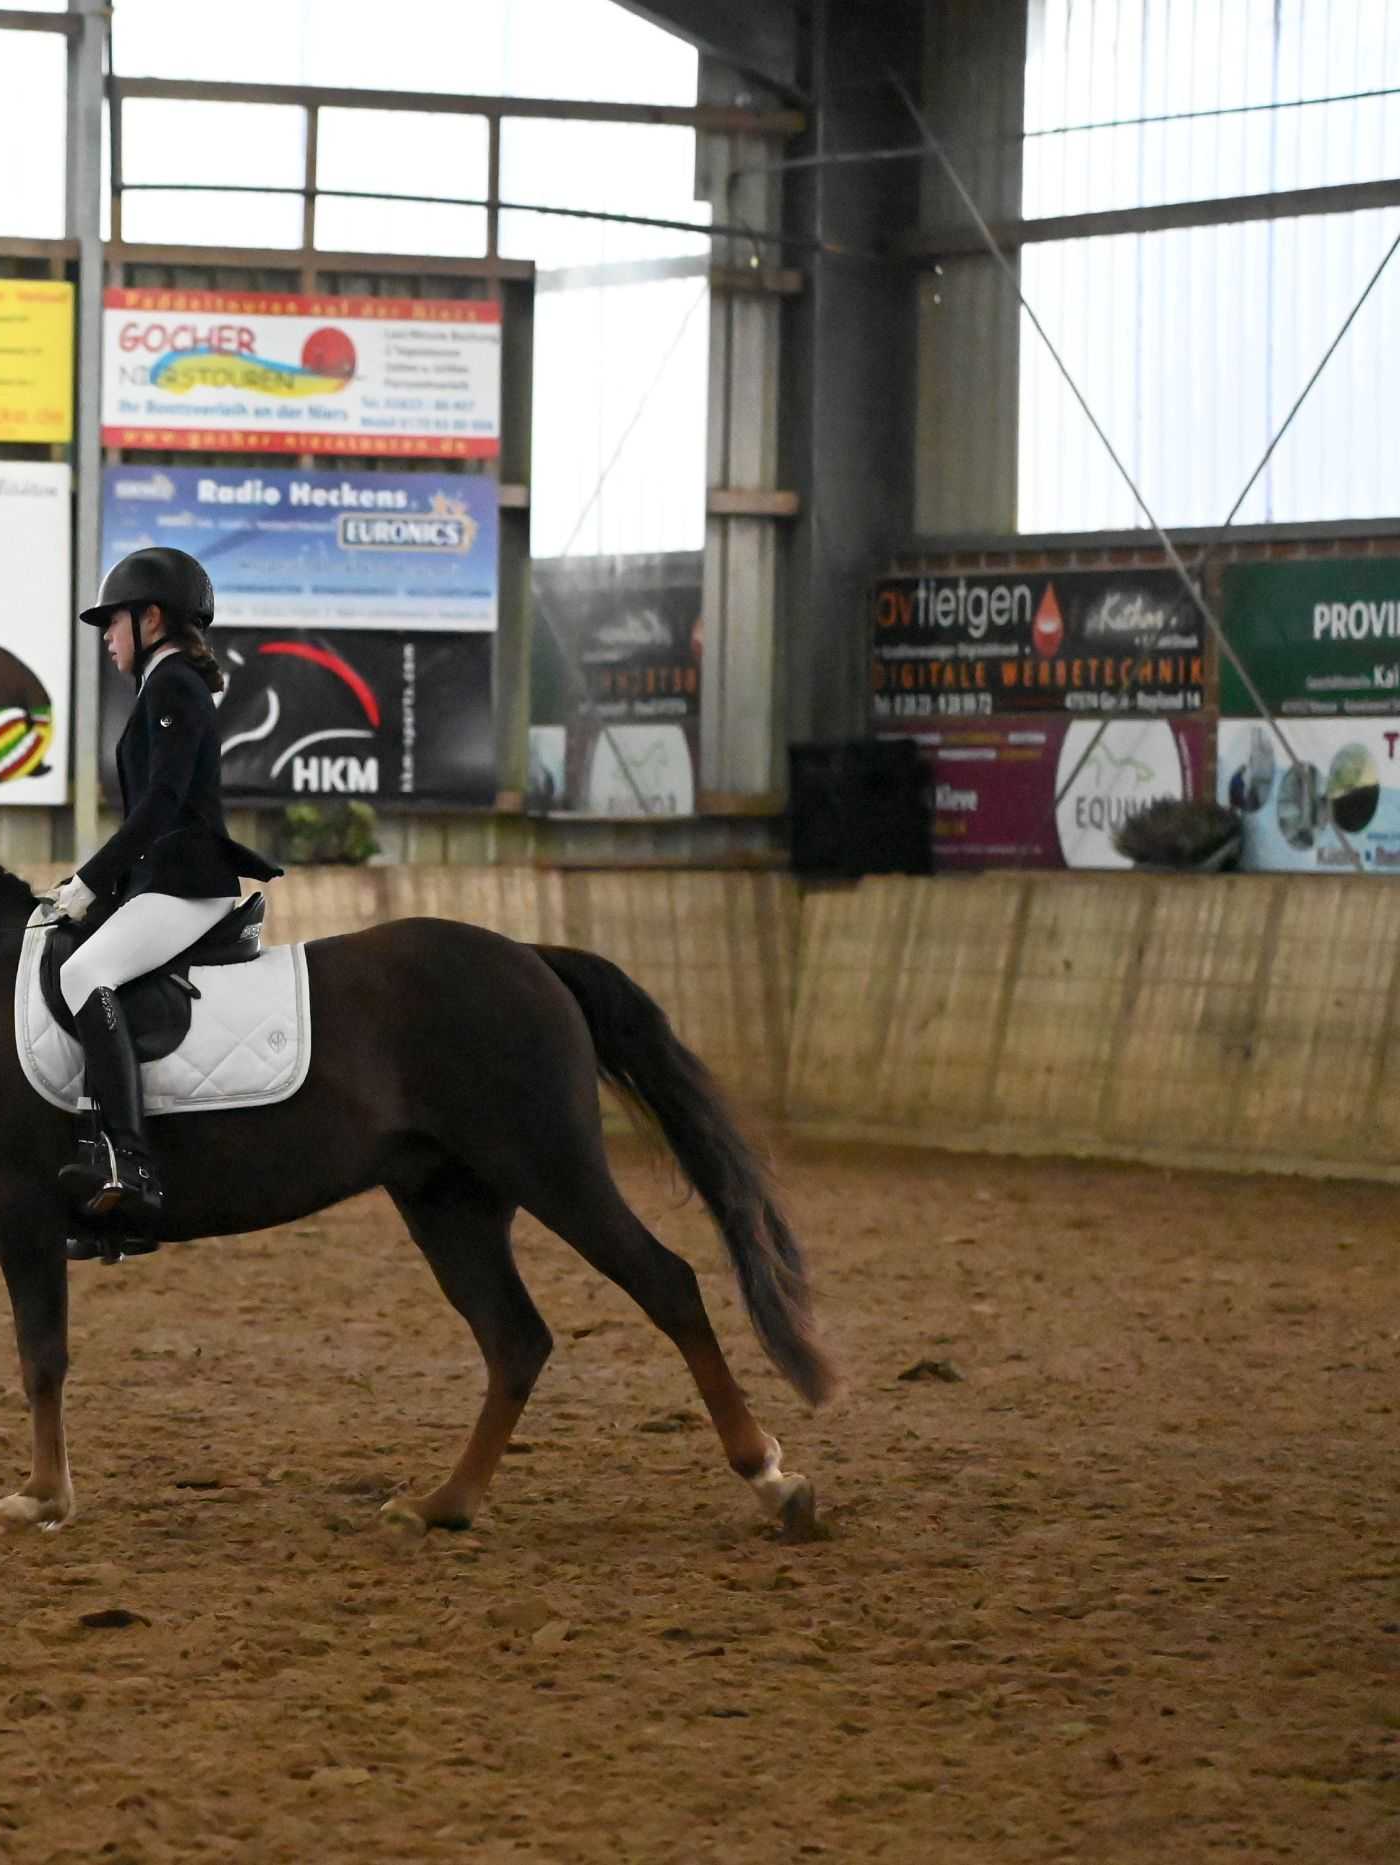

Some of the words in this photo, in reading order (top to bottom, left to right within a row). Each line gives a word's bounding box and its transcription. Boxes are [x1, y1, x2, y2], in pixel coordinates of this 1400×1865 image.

[118, 321, 258, 356] GOCHER
[197, 479, 282, 507] Radio
[345, 519, 461, 546] EURONICS
[292, 755, 380, 794] HKM
